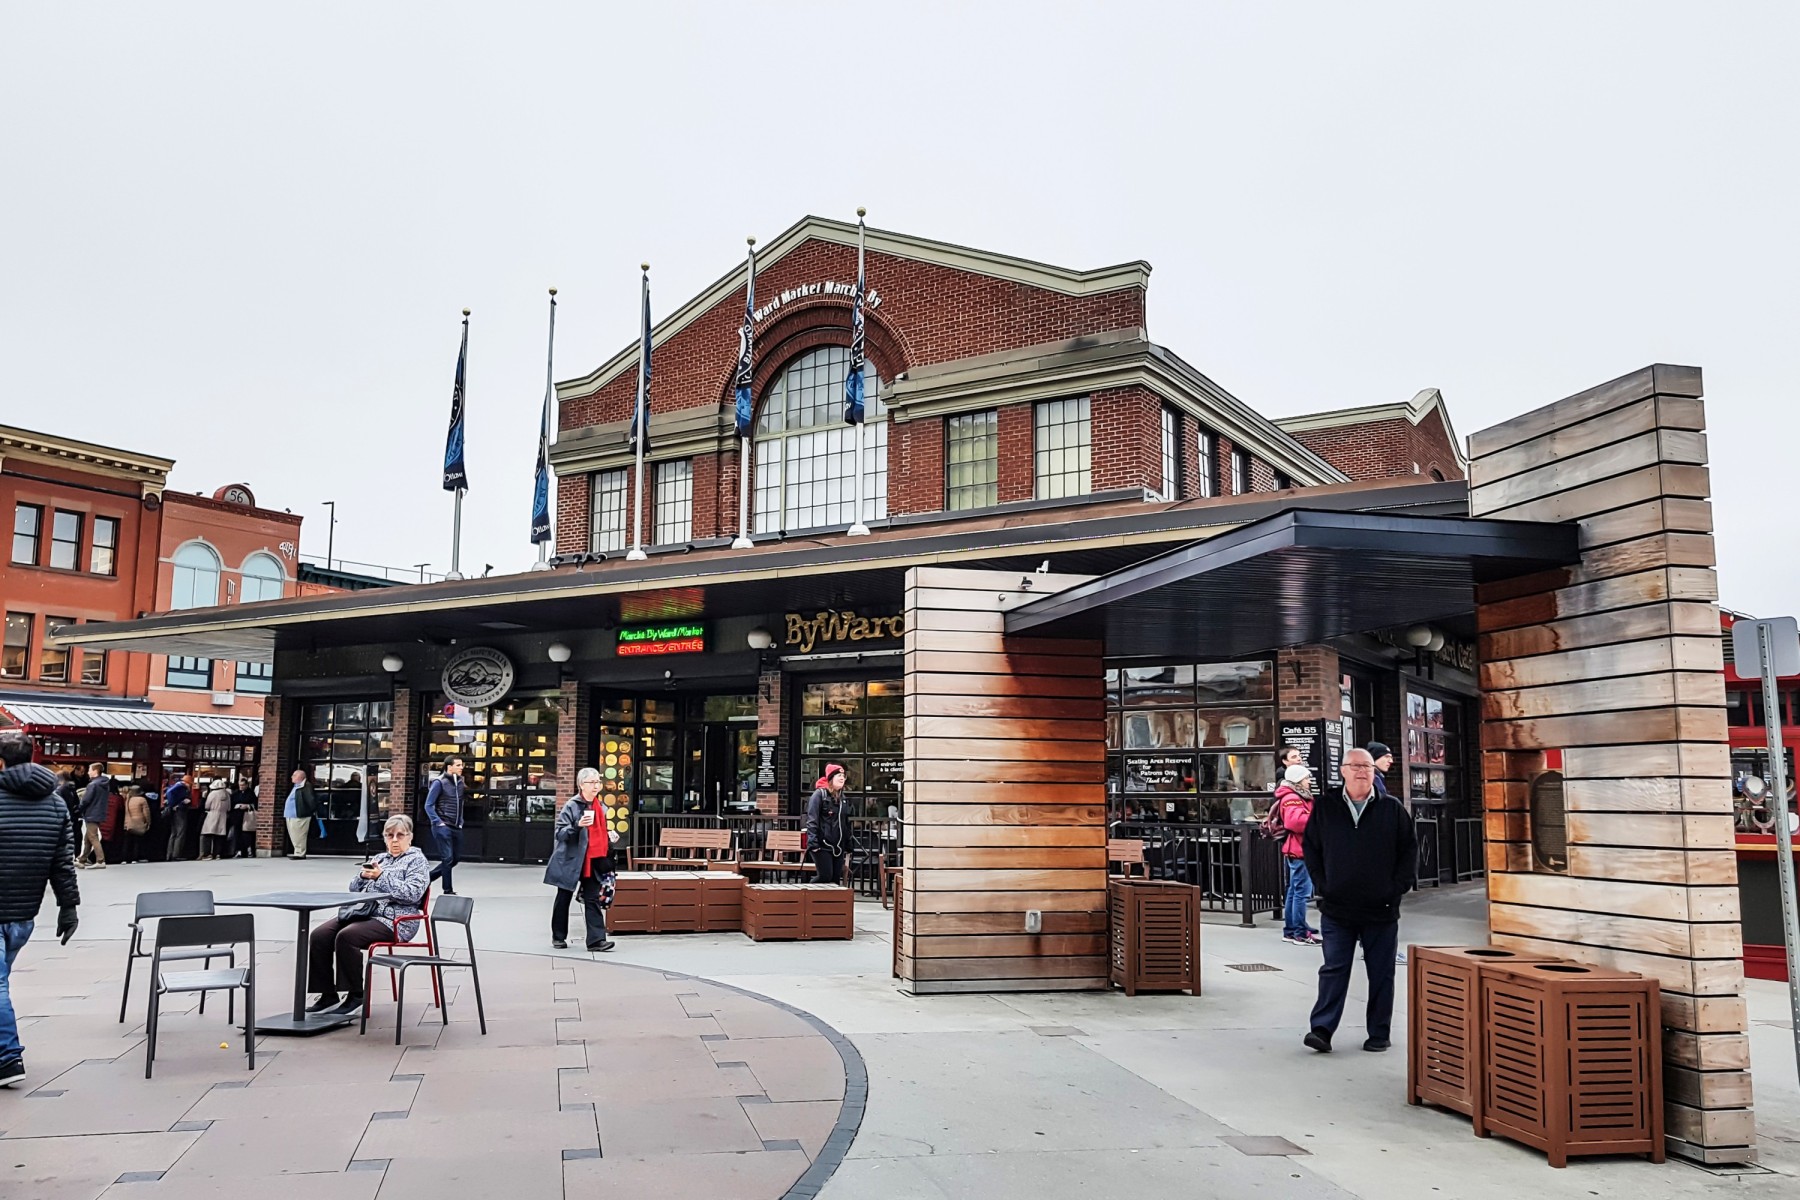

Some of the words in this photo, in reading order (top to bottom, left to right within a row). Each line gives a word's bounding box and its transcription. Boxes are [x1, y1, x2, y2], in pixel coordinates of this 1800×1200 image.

[752, 297, 780, 323] Ward
[780, 282, 821, 305] Market
[823, 281, 858, 298] March
[866, 289, 883, 309] By
[230, 490, 244, 503] 56
[480, 683, 506, 703] FACTORY
[1283, 726, 1302, 734] Café
[1304, 726, 1317, 734] 55
[1160, 776, 1174, 784] You!
